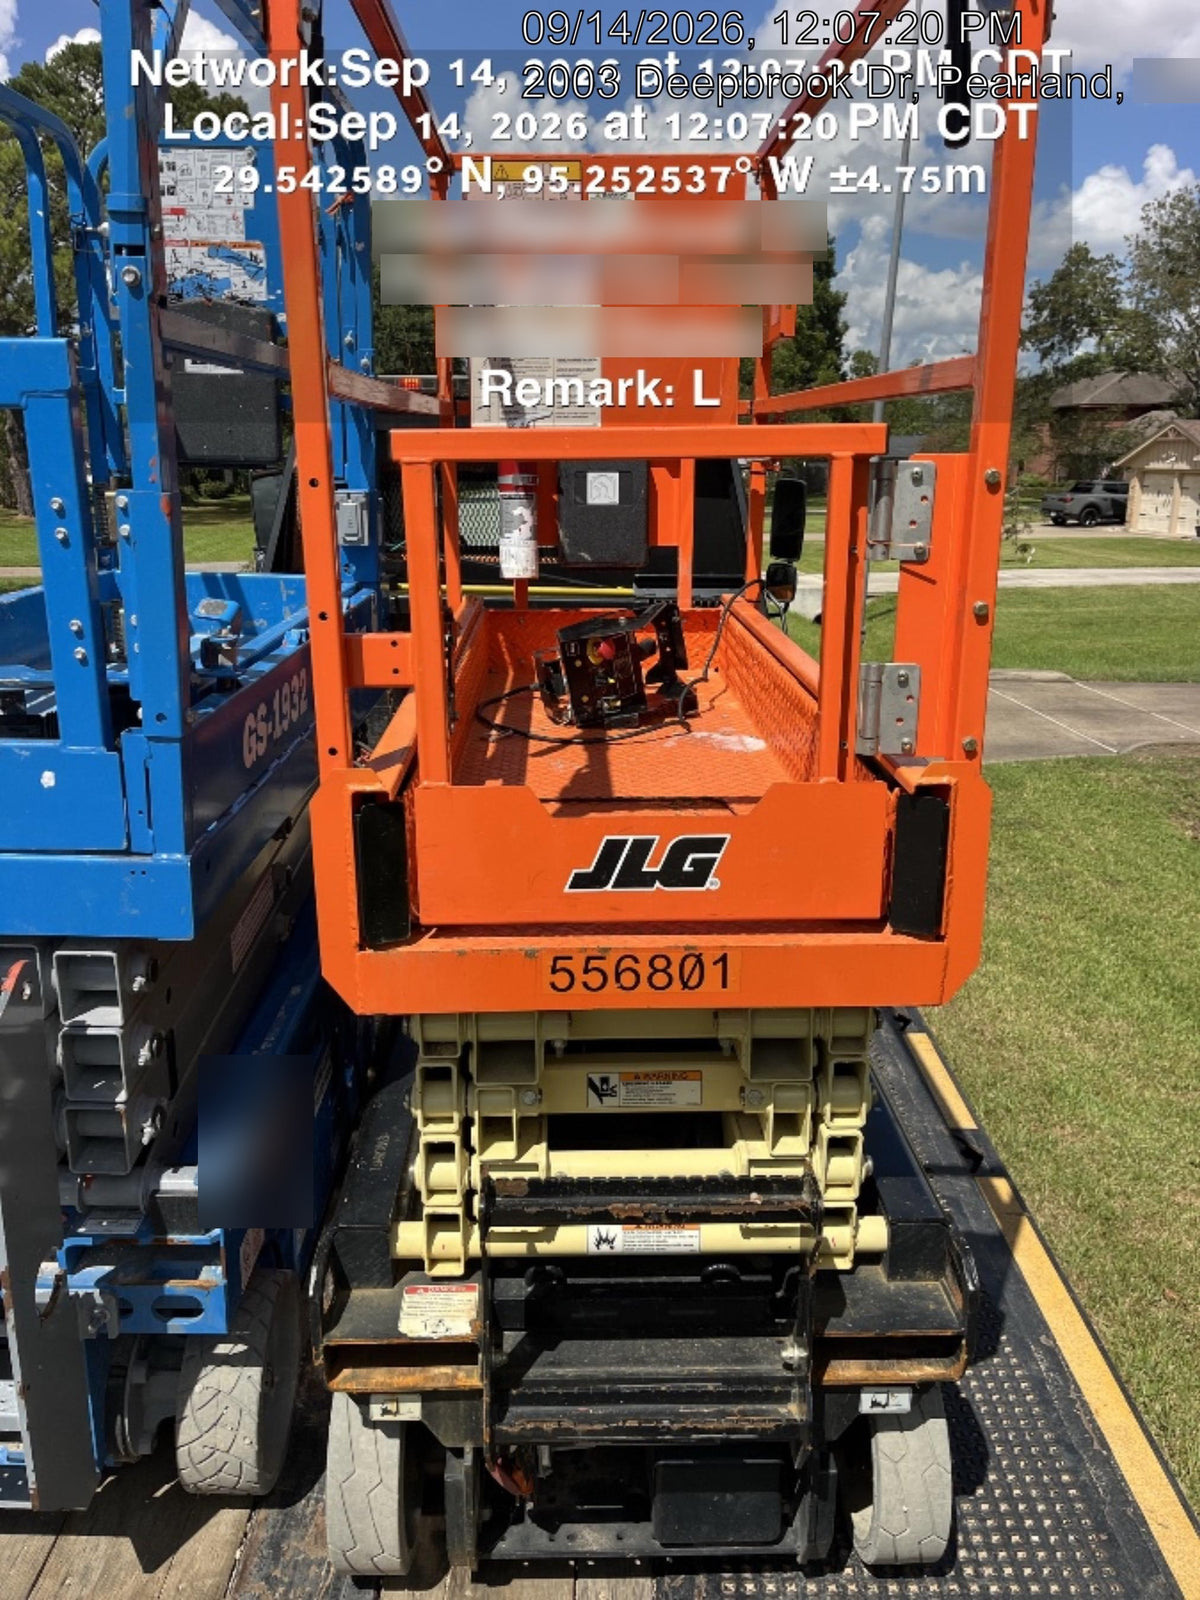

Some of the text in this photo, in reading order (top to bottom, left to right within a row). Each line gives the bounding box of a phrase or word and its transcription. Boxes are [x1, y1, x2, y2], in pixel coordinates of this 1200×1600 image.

[243, 667, 308, 769] GS-1932
[564, 834, 731, 892] JLG
[549, 952, 729, 993] 556801
